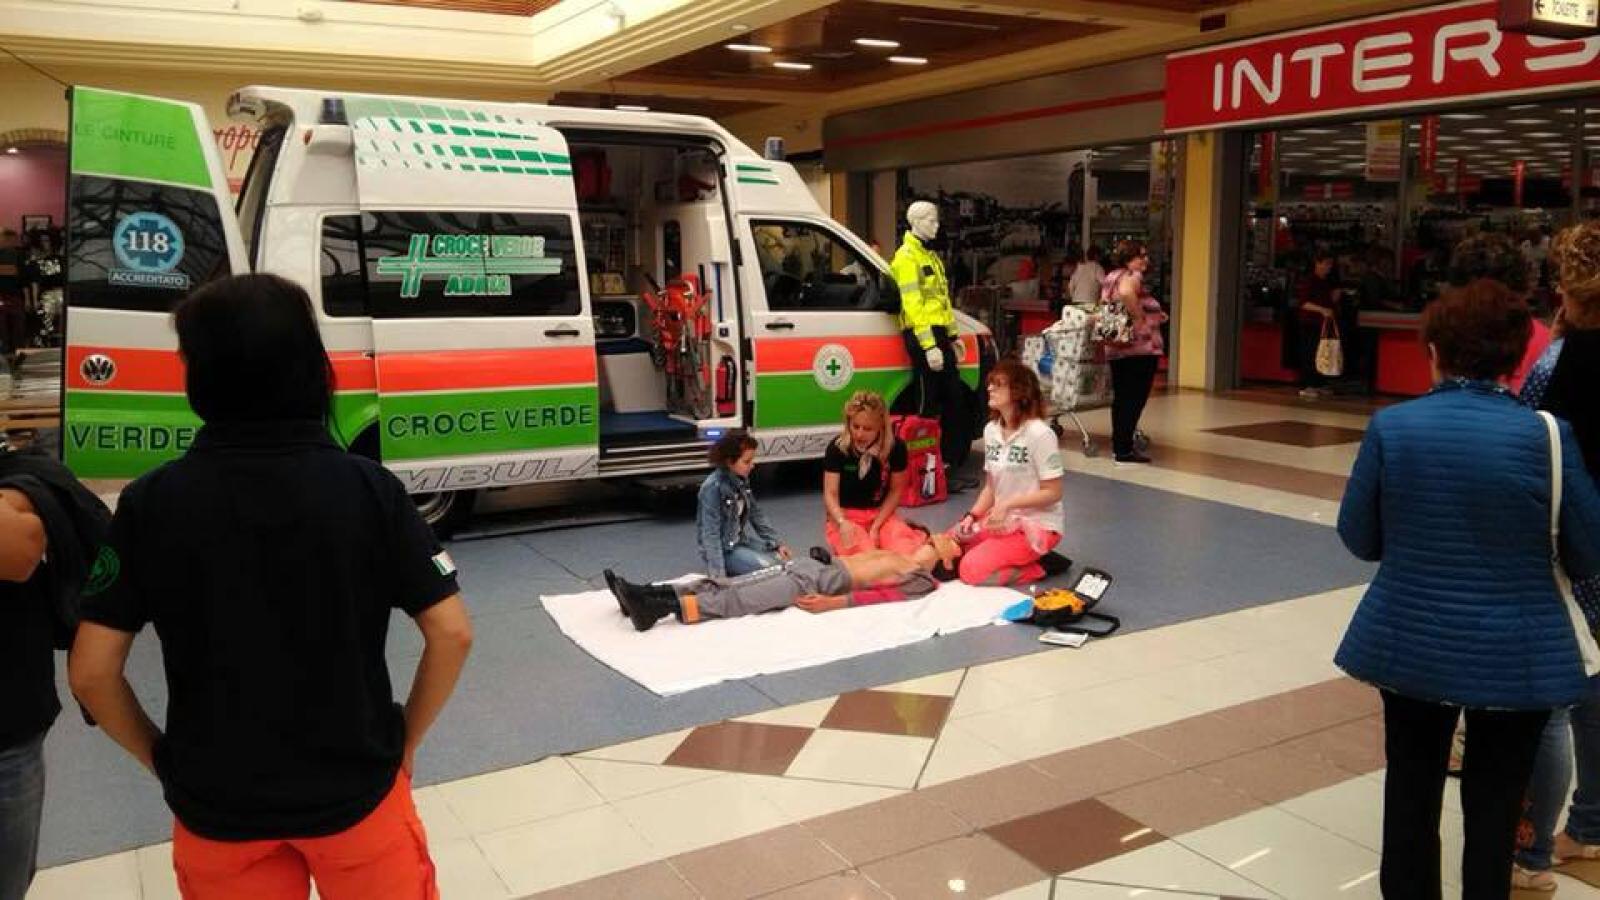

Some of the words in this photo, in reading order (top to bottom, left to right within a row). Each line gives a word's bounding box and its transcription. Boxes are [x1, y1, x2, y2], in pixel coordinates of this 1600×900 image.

[127, 230, 169, 253] 118
[432, 234, 489, 257] CROCE
[112, 272, 184, 287] ACCREDITATO
[387, 410, 497, 438] CROCE
[504, 404, 593, 429] VERDE
[69, 424, 194, 450] VERDE
